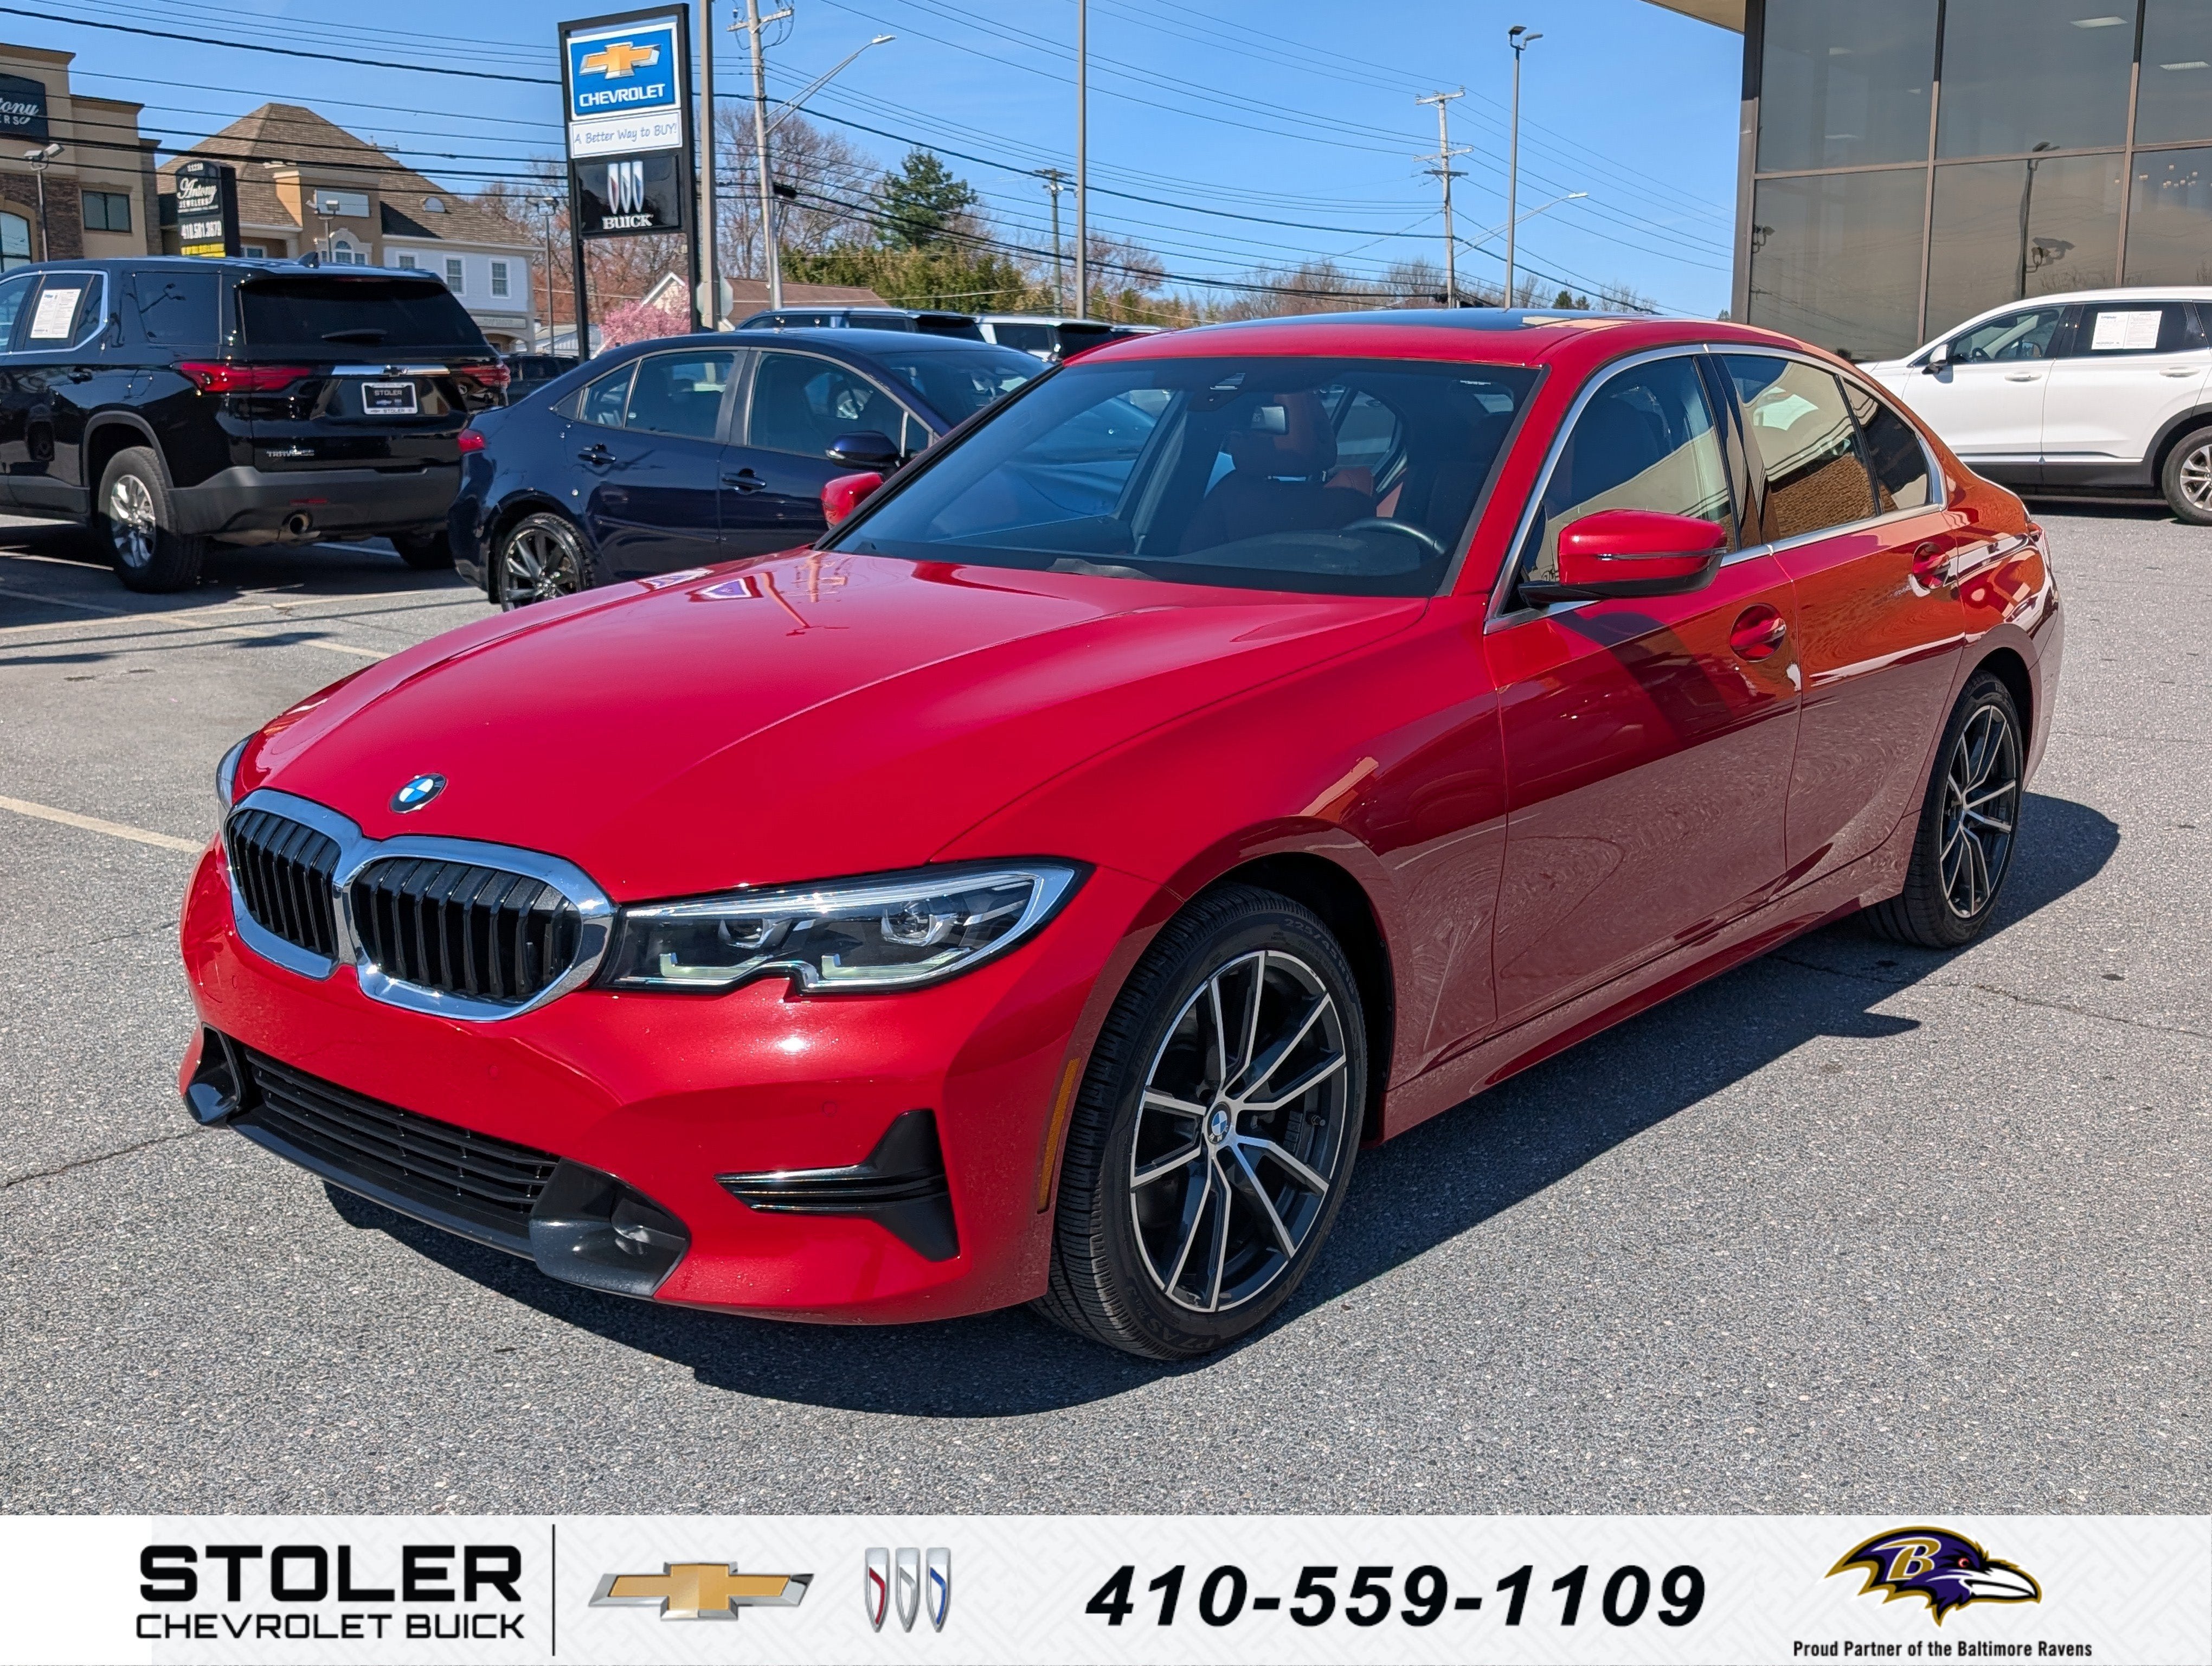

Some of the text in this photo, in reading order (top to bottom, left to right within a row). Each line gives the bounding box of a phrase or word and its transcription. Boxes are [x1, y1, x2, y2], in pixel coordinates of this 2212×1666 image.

[579, 84, 666, 107] CHEVROLET
[0, 98, 39, 125] ony
[573, 123, 677, 144] A Better Way to BUY!
[177, 177, 217, 204] Antony
[602, 213, 654, 229] BUICK
